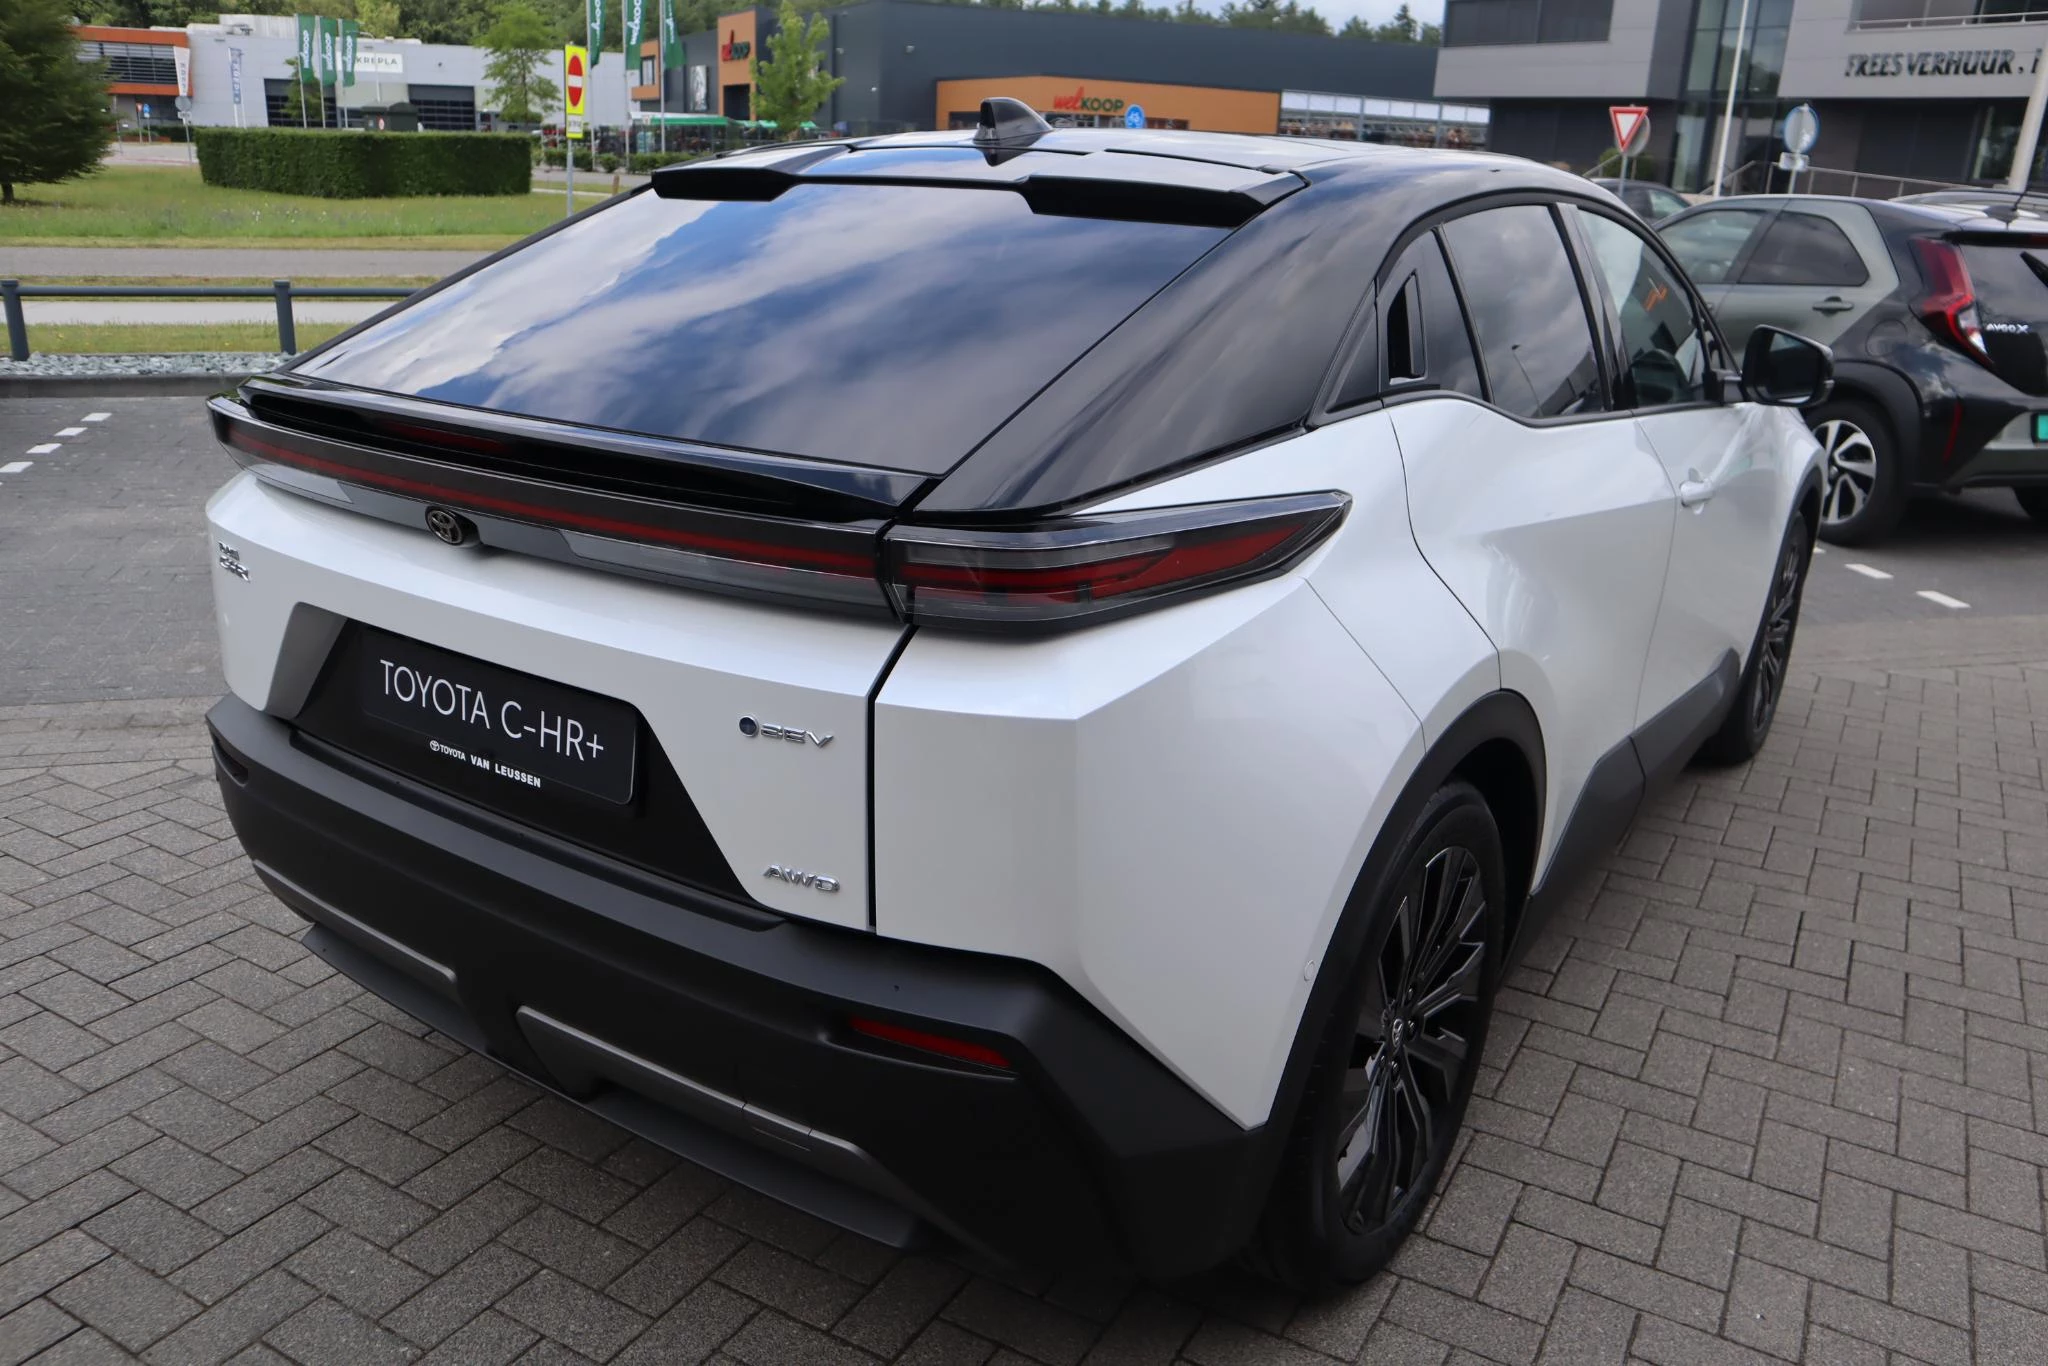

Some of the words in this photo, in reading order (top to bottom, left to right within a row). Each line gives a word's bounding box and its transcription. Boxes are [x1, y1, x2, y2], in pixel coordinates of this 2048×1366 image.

[380, 659, 491, 730] TOYOTA
[501, 700, 605, 762] C-HR+
[440, 743, 467, 762] TOYOTA
[470, 754, 490, 771] VAN
[495, 762, 542, 788] LEUSSEN
[763, 864, 840, 892] AWD
